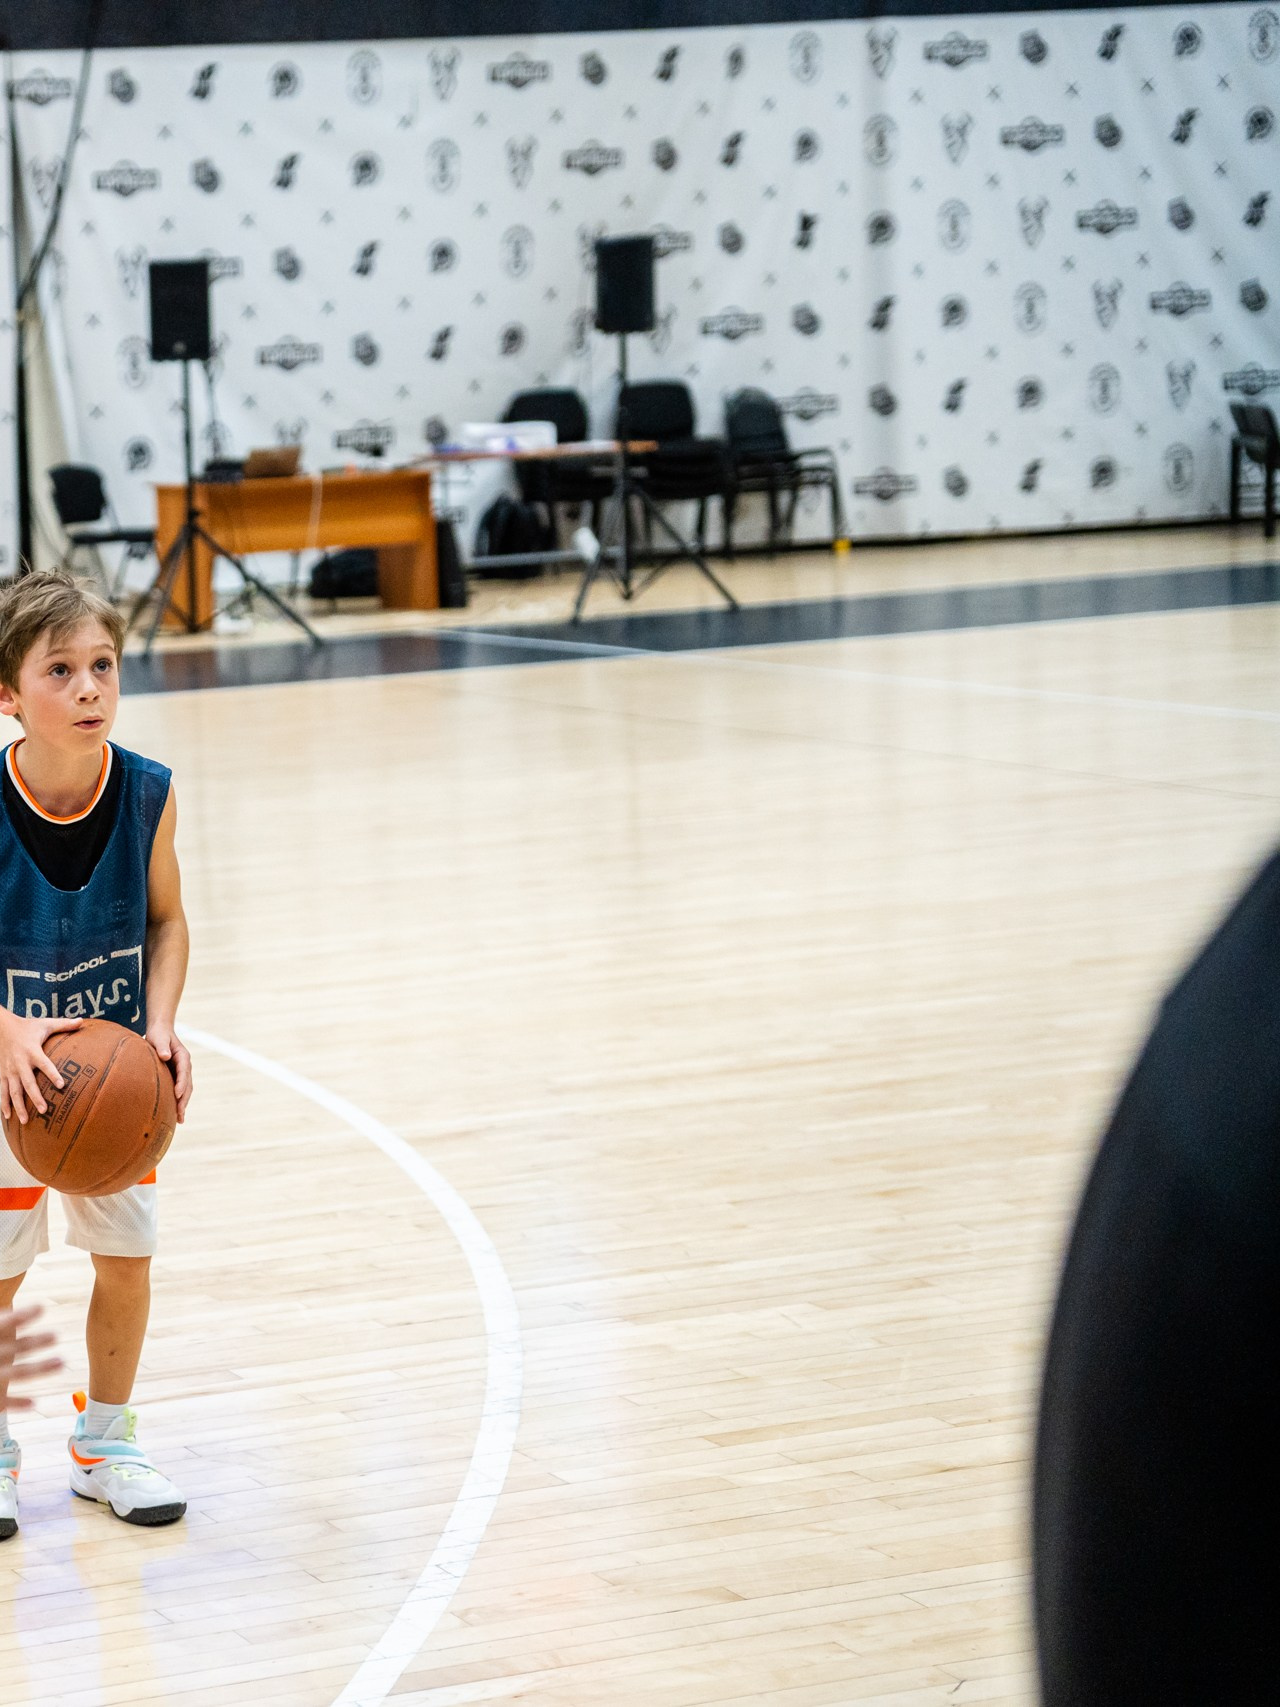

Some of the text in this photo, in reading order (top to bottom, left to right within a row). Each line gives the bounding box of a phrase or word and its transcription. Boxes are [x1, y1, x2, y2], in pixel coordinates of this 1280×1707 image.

[44, 955, 108, 982] SCHOOL
[25, 977, 131, 1019] plays.
[57, 1090, 77, 1124] TRAINING
